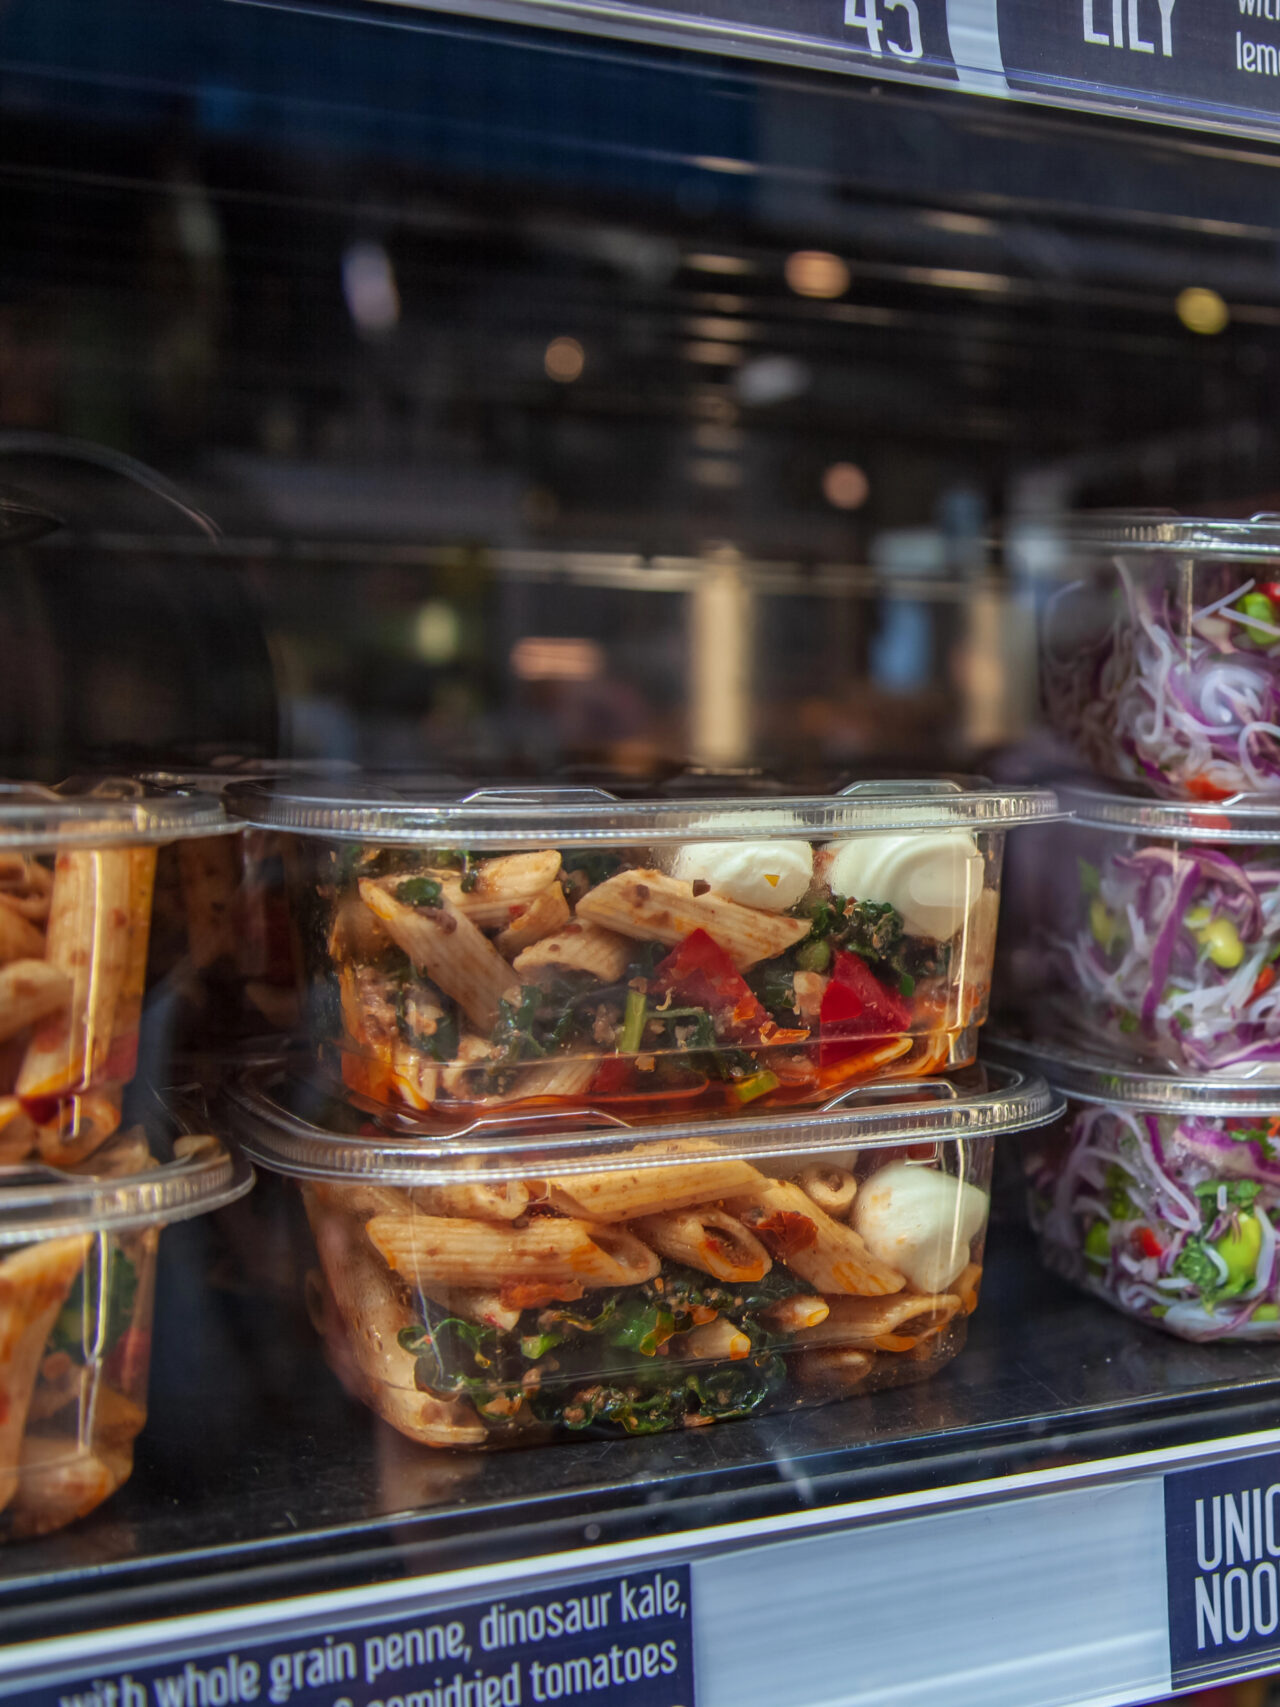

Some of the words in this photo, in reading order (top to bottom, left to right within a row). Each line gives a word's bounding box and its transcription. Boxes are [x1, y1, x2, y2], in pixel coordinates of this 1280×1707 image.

[59, 1674, 147, 1707] ith
[154, 1654, 261, 1707] whole
[269, 1635, 357, 1703] grain
[364, 1621, 472, 1684] penne,
[480, 1592, 612, 1651] dinosaur
[619, 1573, 686, 1620] kale,
[365, 1661, 522, 1707] idried
[530, 1638, 679, 1702] tomatoes
